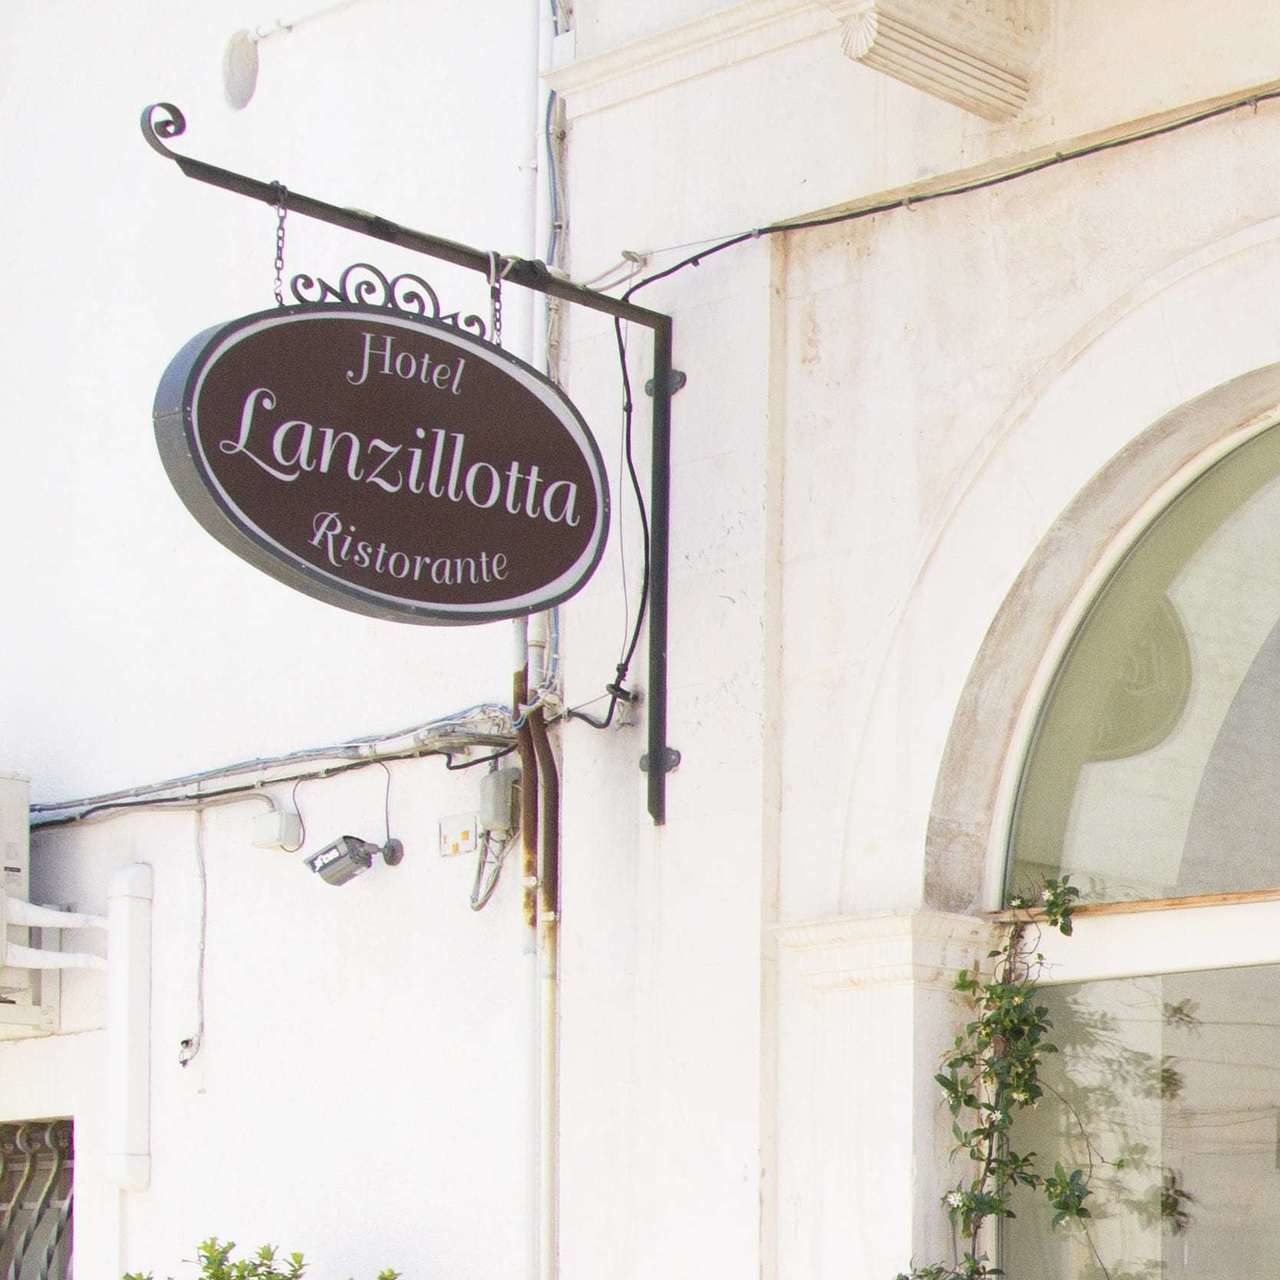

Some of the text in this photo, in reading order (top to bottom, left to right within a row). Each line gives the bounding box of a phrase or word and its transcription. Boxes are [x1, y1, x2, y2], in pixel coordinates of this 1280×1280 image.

[346, 332, 466, 395] Hotel
[219, 387, 580, 527] Lanzillotta
[307, 511, 509, 585] Ristorante
